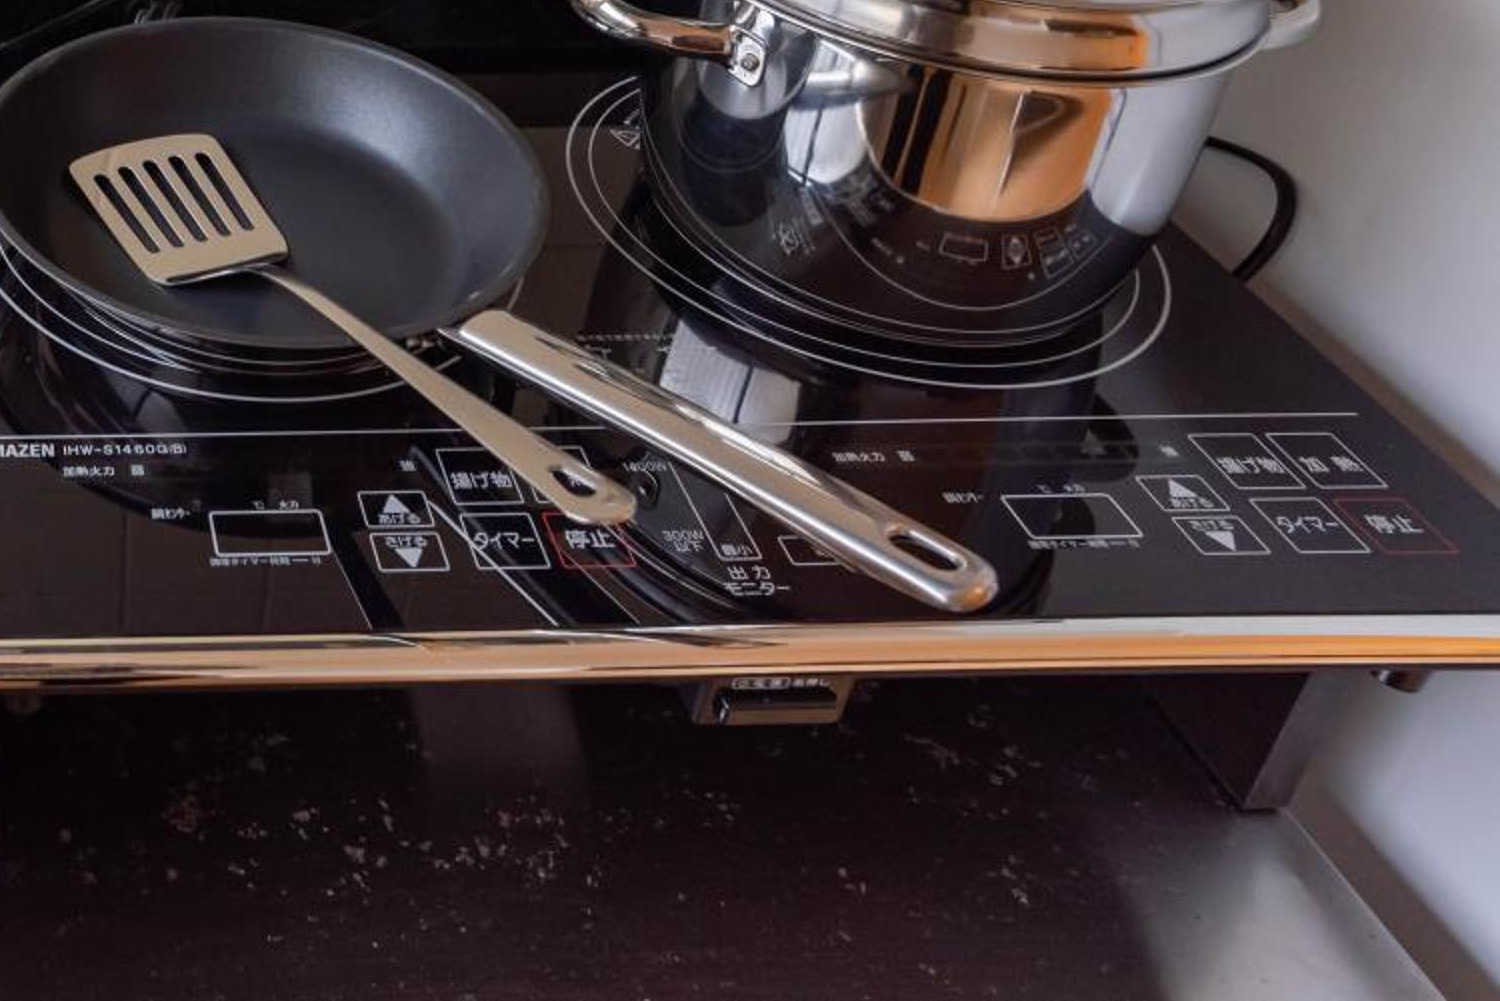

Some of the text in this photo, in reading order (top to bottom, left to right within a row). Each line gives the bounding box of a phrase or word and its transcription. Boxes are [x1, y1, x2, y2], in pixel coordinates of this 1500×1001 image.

[450, 471, 514, 490] 揚げ物
[472, 531, 535, 550] タイマー
[564, 529, 617, 549] 停止
[727, 565, 771, 581] 出力
